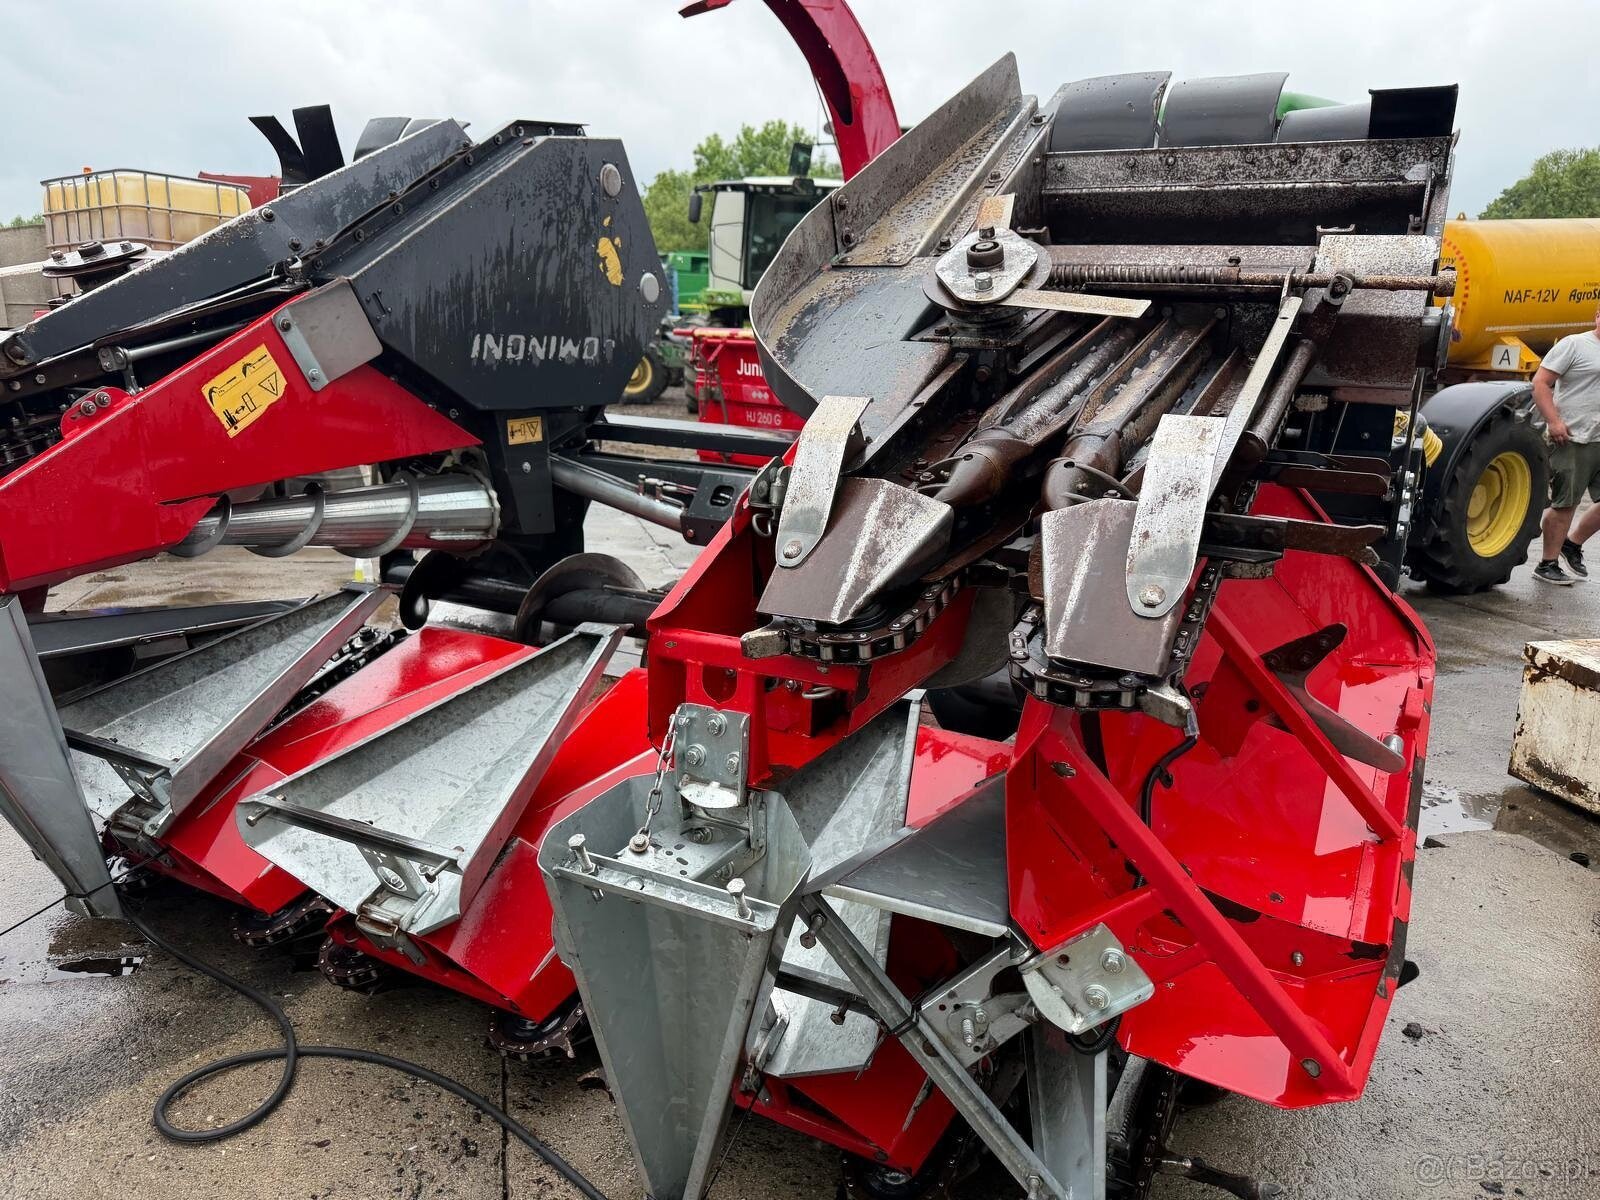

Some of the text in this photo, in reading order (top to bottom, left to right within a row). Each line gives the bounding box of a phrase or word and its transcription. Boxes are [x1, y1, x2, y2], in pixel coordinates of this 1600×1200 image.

[1503, 289, 1560, 303] NAF-12V
[1498, 349, 1511, 366] A
[746, 410, 782, 426] HJ 260 G
